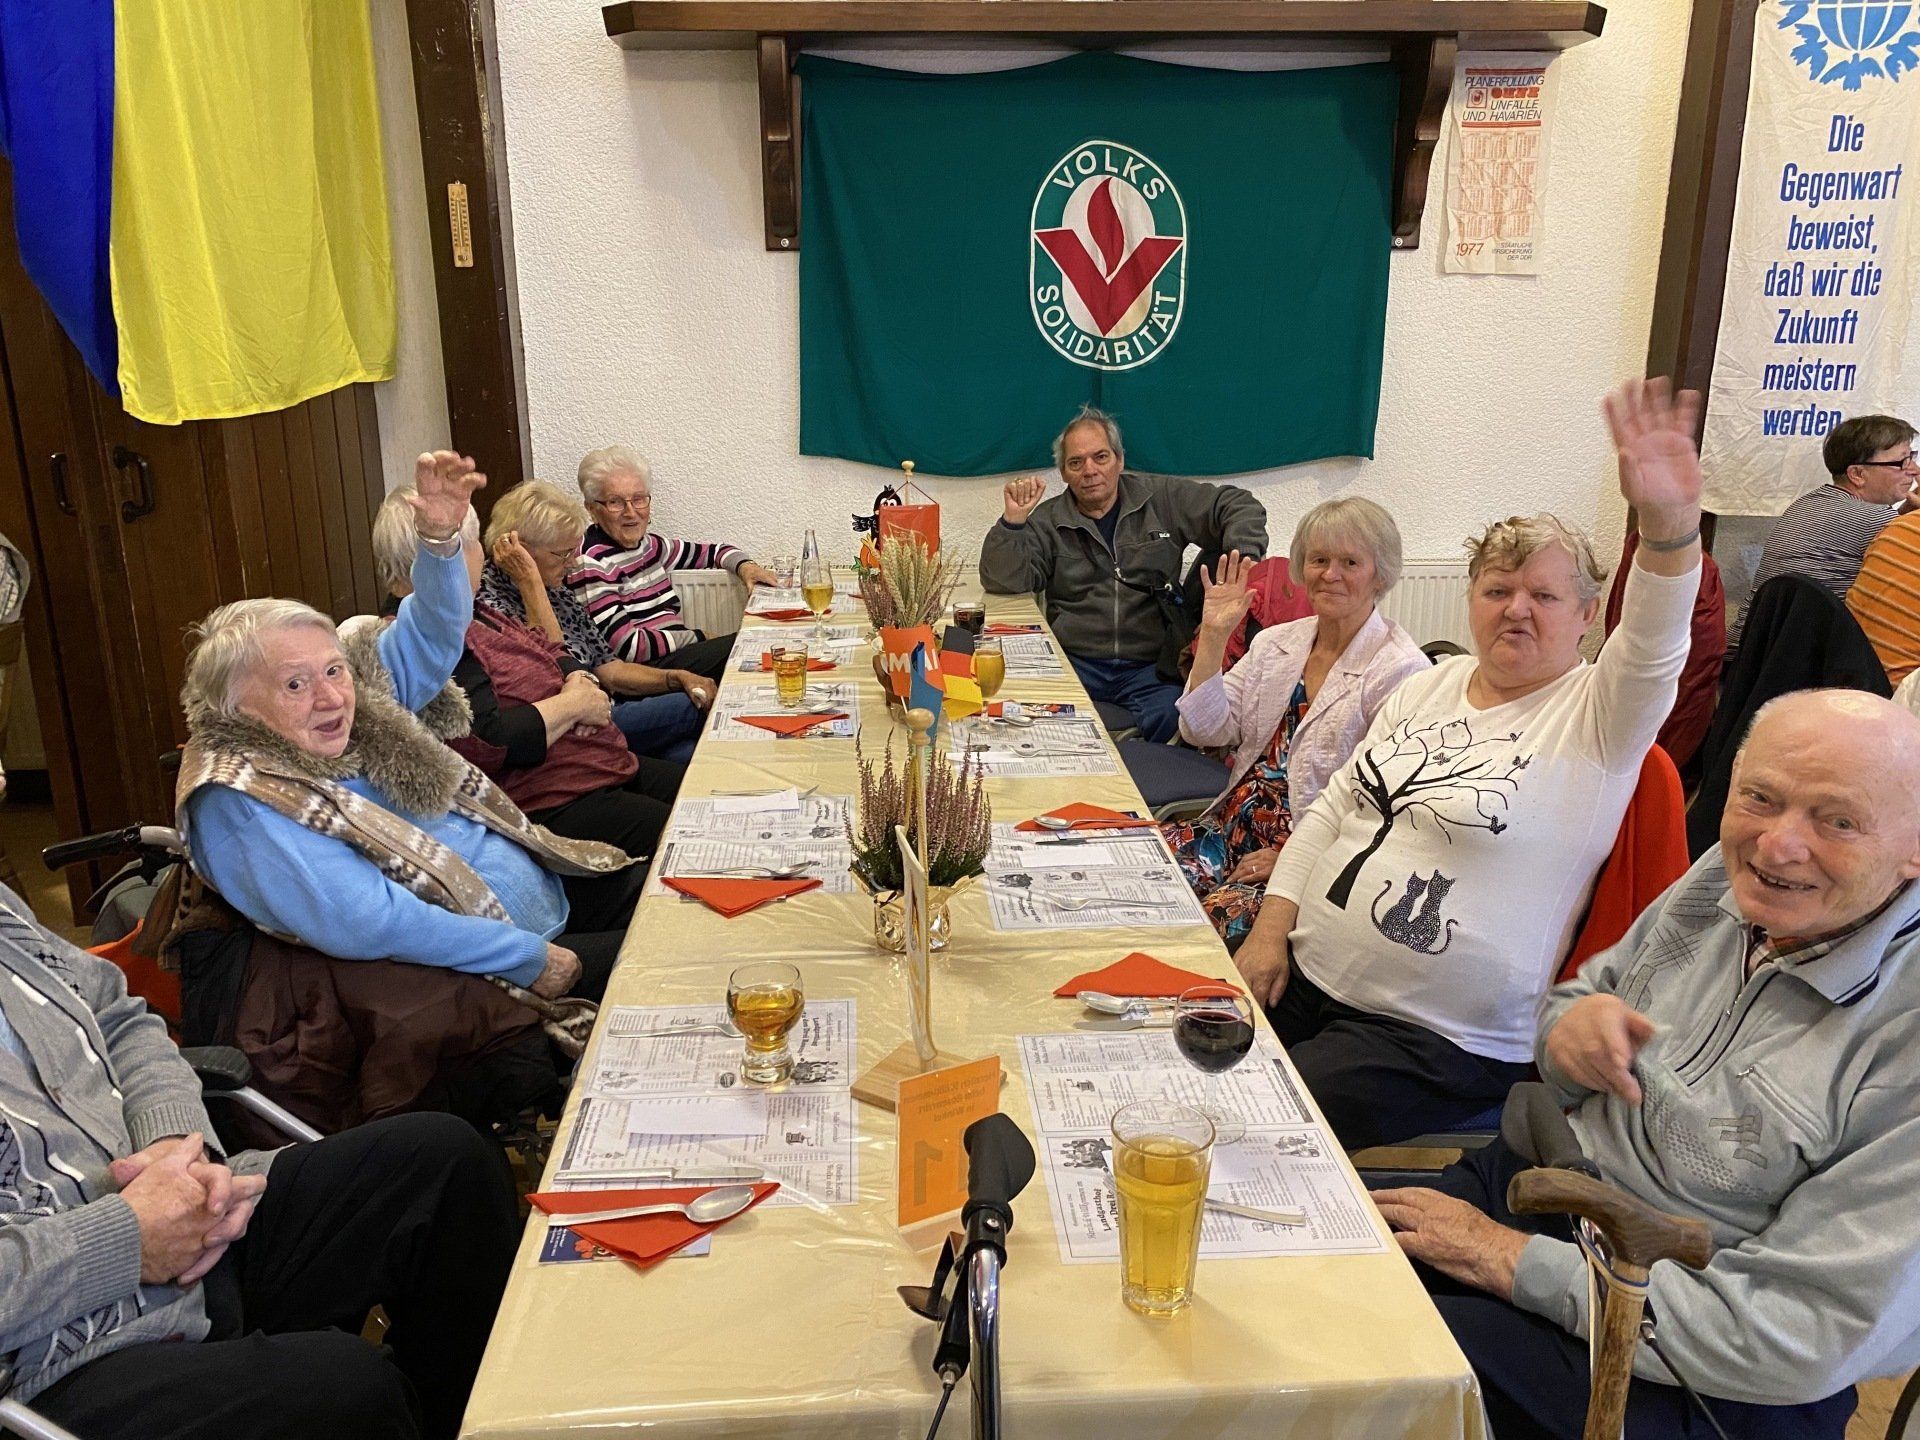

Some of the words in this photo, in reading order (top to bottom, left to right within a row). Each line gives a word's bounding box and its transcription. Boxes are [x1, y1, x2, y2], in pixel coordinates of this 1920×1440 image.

[1462, 111, 1487, 121] UND
[1489, 109, 1542, 121] HAVARIEN
[1828, 115, 1864, 152] Die
[1053, 148, 1166, 200] VOLKS
[1780, 163, 1902, 208] Gegenwart
[1456, 242, 1485, 256] 1977
[1787, 214, 1878, 254] beweist,
[1764, 262, 1805, 296] daß
[1812, 262, 1848, 296] wir
[1850, 261, 1882, 296] die
[1037, 284, 1177, 364] SOLIDARITÄT
[1774, 309, 1858, 344] Zukunft
[1763, 357, 1857, 391] meistern
[1093, 1188, 1112, 1231] Landgasthof
